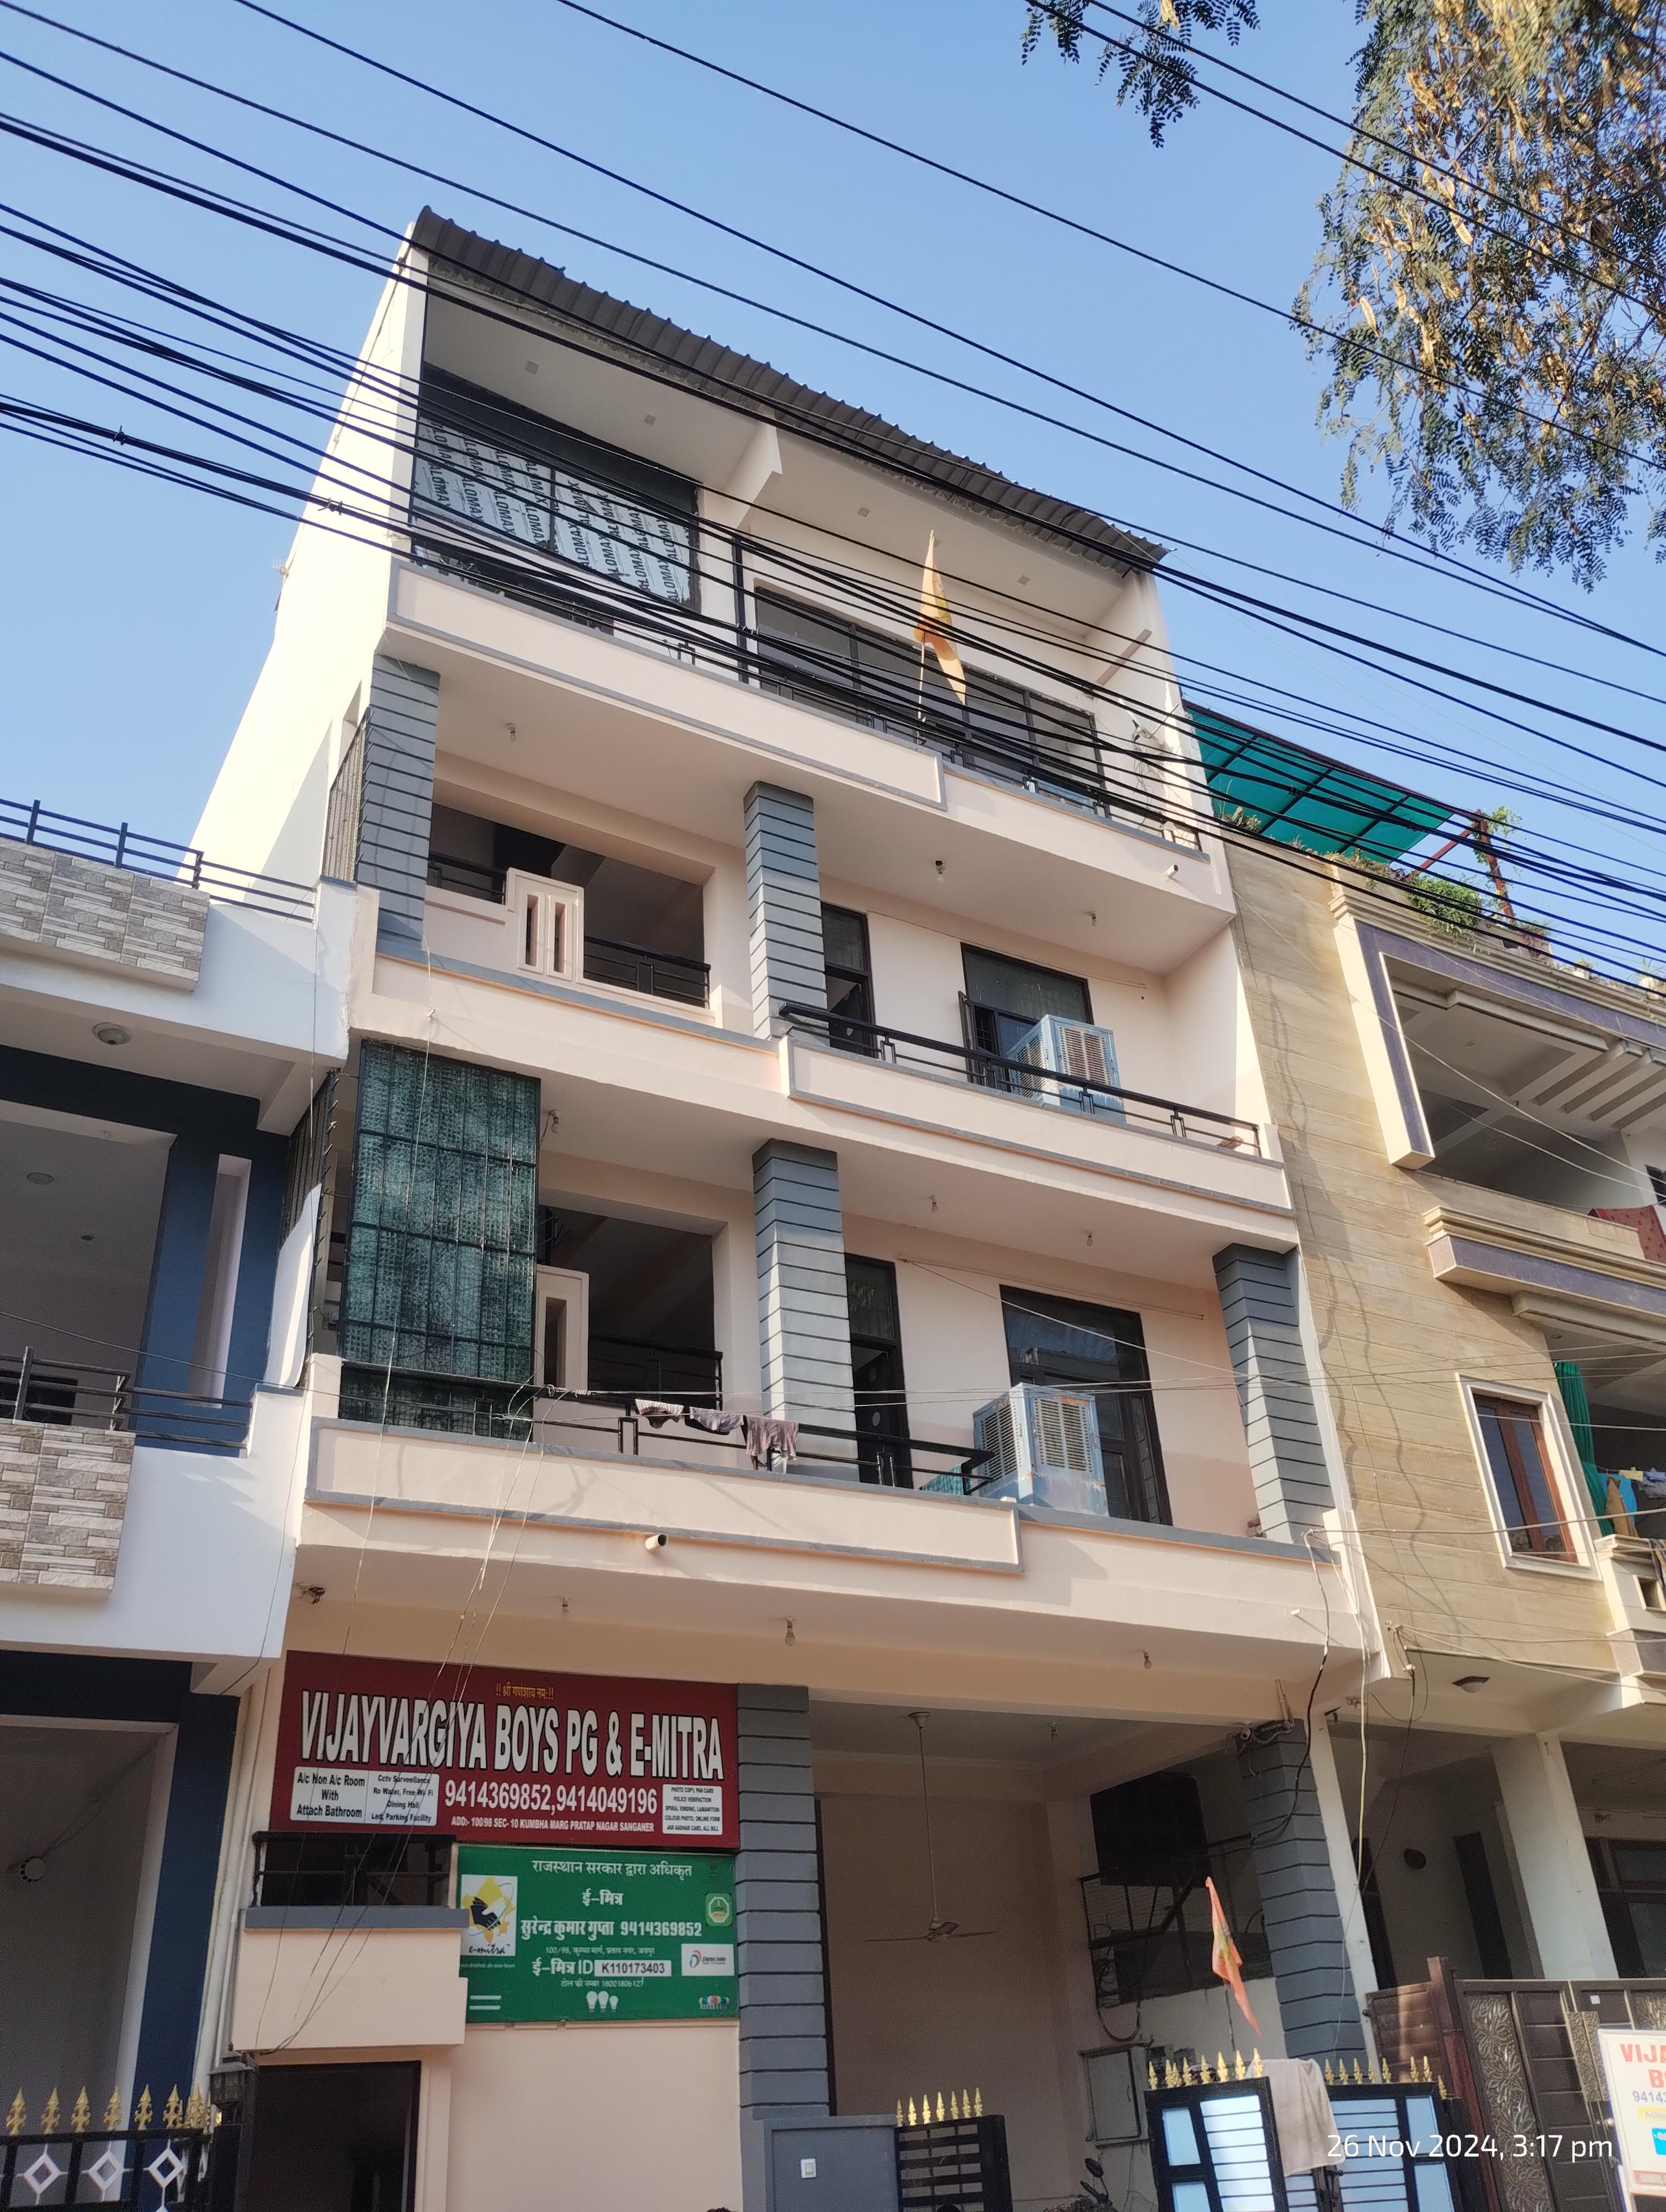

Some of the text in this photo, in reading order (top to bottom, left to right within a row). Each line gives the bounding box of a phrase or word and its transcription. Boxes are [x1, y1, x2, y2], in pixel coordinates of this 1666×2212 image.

[302, 1690, 724, 1779] VIJAYVARGIYA BOYS PG & E-MITRA
[297, 1772, 365, 1786] A/c Non A/c Room
[378, 1774, 392, 1783] Cctv
[322, 1790, 339, 1801] With
[445, 1779, 658, 1816] 9414369852,9414049196
[297, 1804, 362, 1818] Attach Bathroom
[387, 1801, 419, 1810] Dining Hall
[386, 1814, 408, 1822] Parking
[410, 1814, 432, 1823] Facility
[511, 1818, 519, 1828] 10
[520, 1819, 548, 1829] KUMBHA
[550, 1820, 569, 1830] MARG
[570, 1821, 595, 1830] PRATAP
[596, 1821, 619, 1831] NAGAR
[620, 1822, 655, 1832] SANGANER
[532, 1860, 693, 1881] राजस्थान सरकार द्वारा अधिकृत
[521, 1915, 702, 1941] सुरेन्द्र कुमार गुप्ता 9414369852
[578, 1959, 593, 1975] ID
[602, 1962, 665, 1975] K110173403
[1649, 2069, 1666, 2088] B
